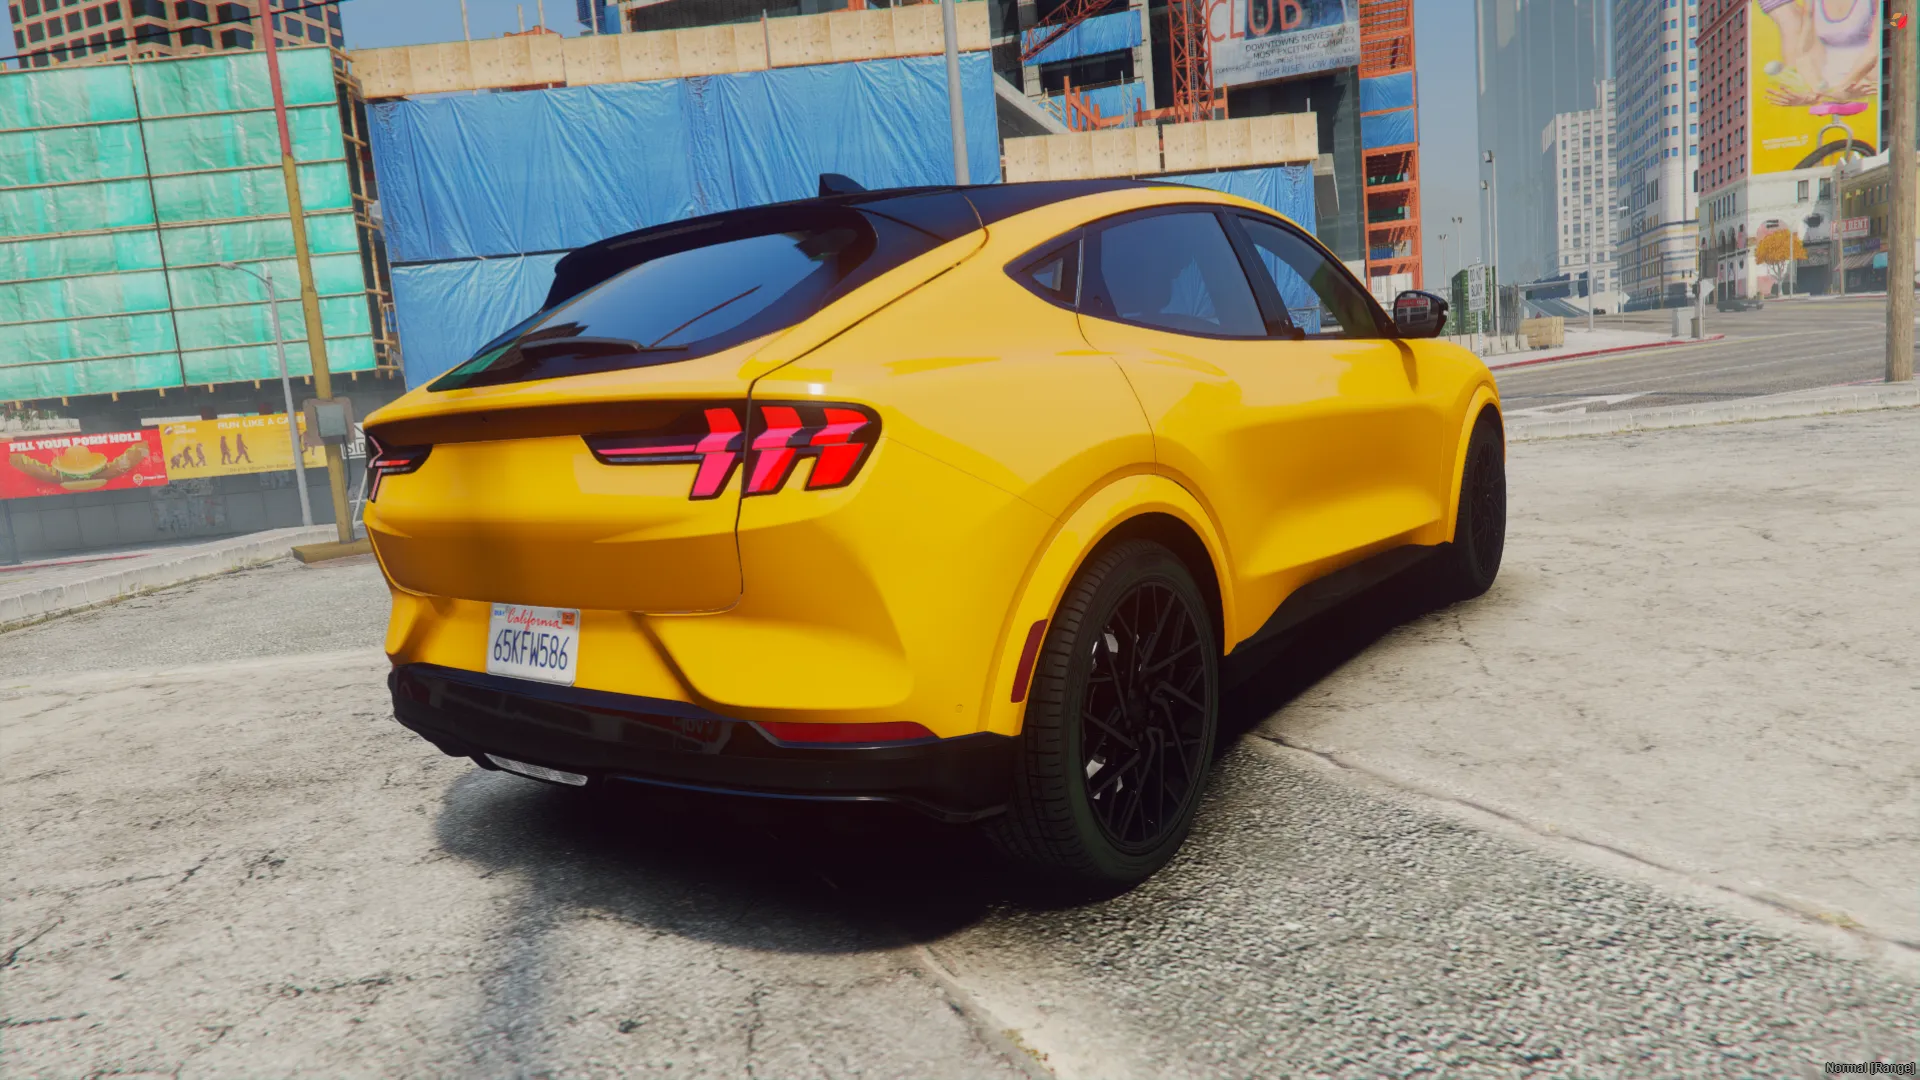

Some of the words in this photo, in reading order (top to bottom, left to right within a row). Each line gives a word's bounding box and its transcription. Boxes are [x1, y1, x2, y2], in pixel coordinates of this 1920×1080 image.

[1210, 0, 1302, 42] CLUB
[1259, 67, 1280, 78] HIGH
[1281, 64, 1301, 75] RISE
[1308, 60, 1326, 71] LOW
[217, 421, 240, 430] RUN
[242, 417, 265, 428] LIKE
[267, 417, 275, 426] A
[9, 442, 35, 453] FILL
[36, 438, 71, 450] YOUR
[72, 434, 108, 448] PORK
[109, 431, 142, 444] HOLE
[507, 607, 563, 631] California
[493, 628, 570, 670] 65KFW586
